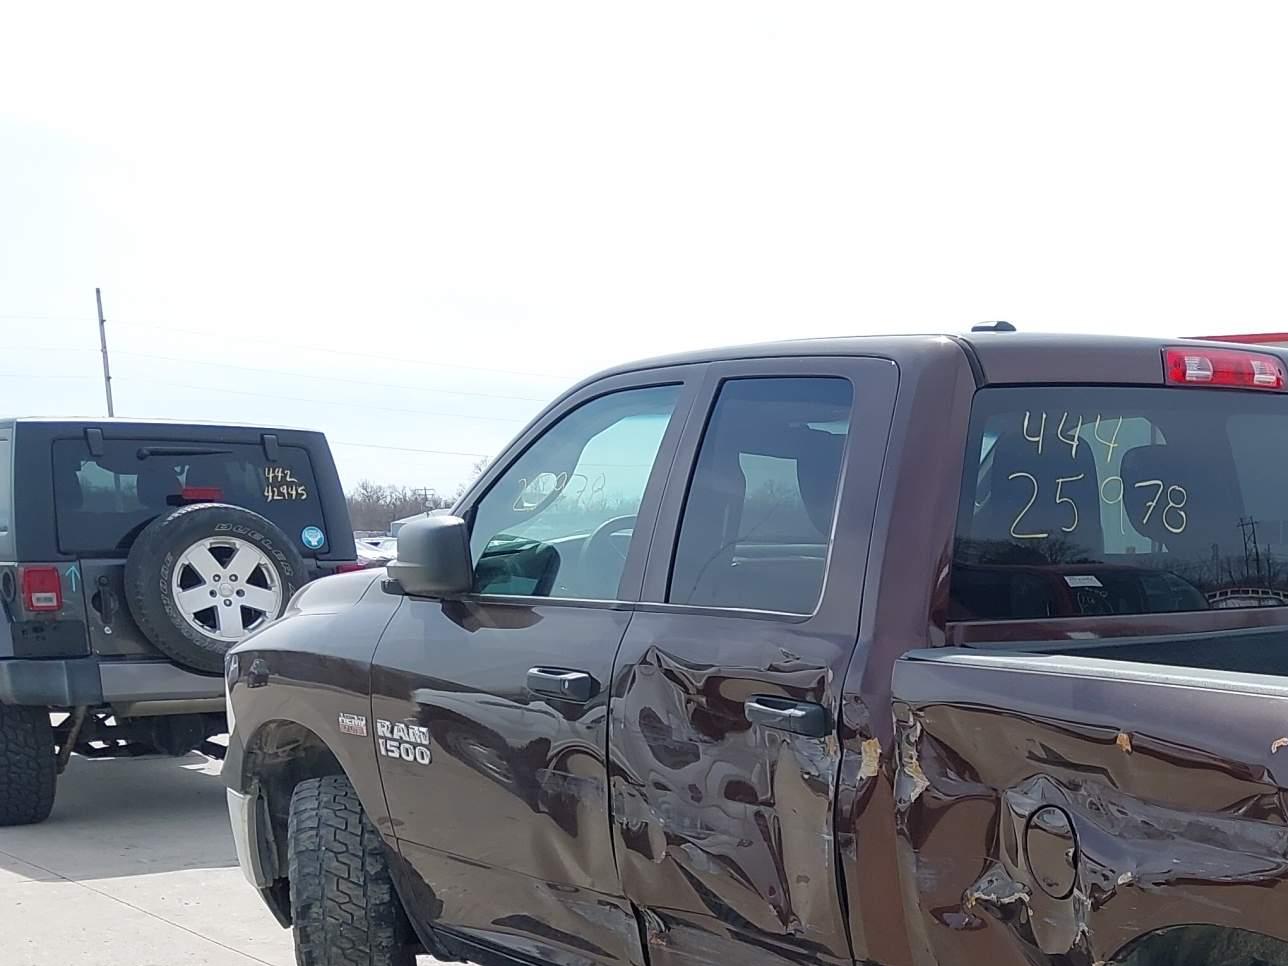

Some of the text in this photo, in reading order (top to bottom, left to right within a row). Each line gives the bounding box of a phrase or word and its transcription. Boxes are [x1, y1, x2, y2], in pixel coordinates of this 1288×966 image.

[1022, 410, 1119, 463] 444
[265, 467, 298, 483] 442
[264, 485, 307, 503] 42945
[1008, 472, 1188, 539] 25978
[376, 719, 430, 745] RAM
[378, 738, 431, 766] 1500
